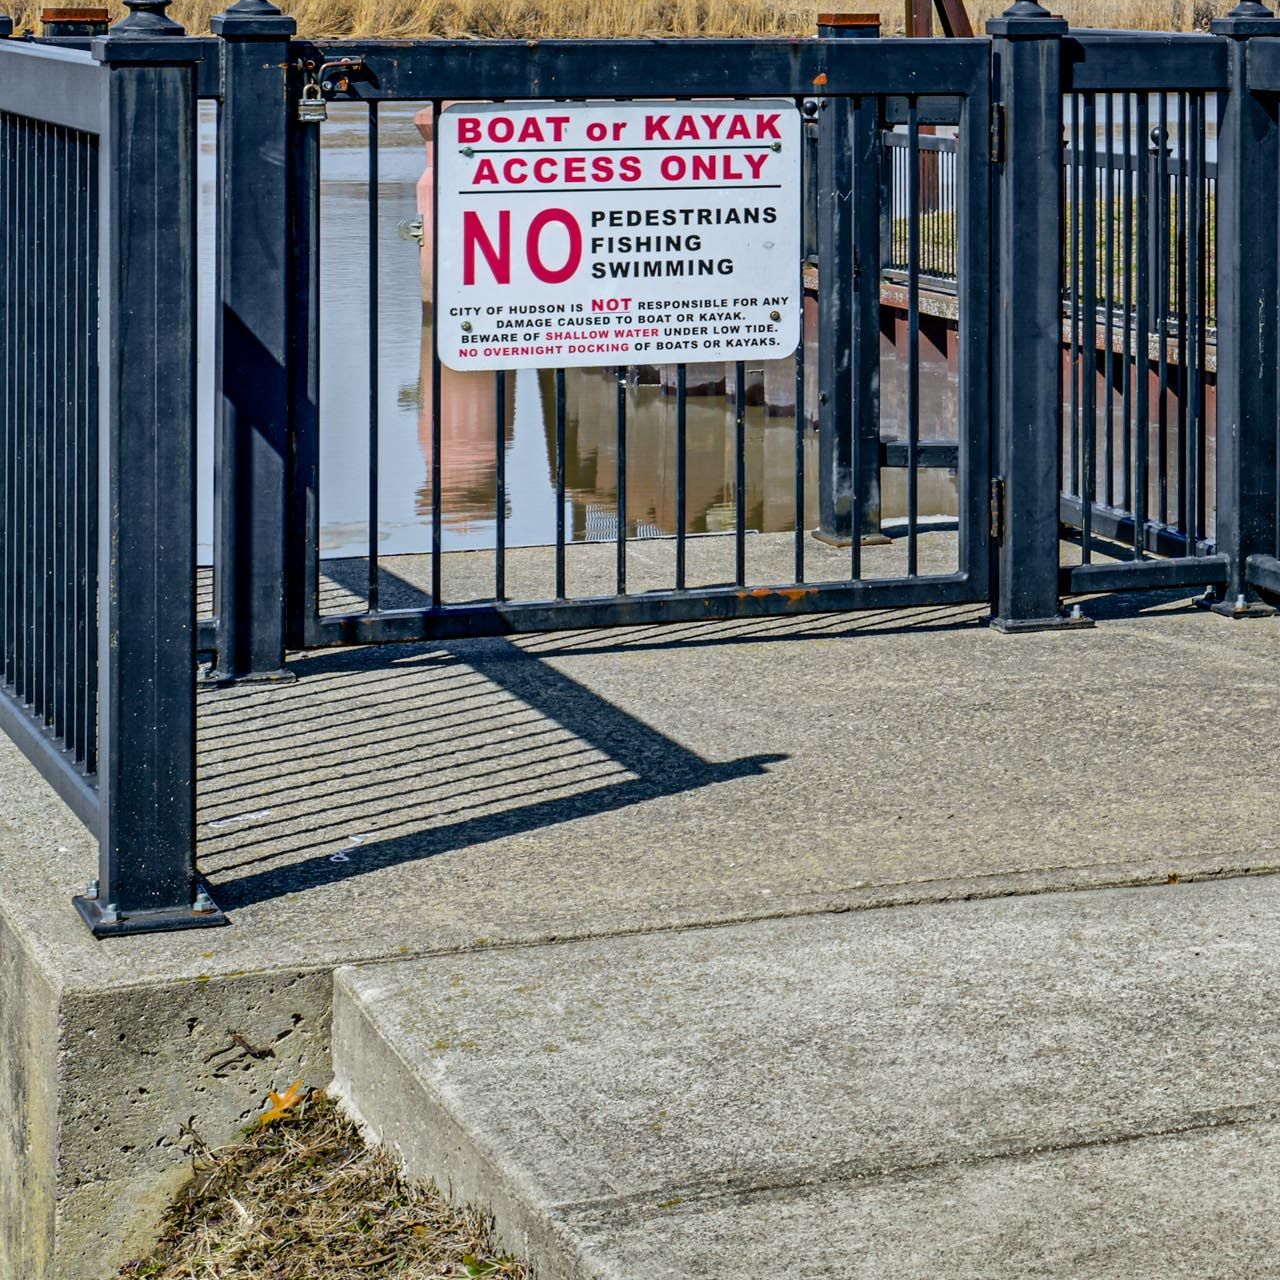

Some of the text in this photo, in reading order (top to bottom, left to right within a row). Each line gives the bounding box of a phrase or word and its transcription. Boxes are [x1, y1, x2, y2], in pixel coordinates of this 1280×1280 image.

[458, 114, 782, 144] BOAT or KAYAK
[472, 154, 769, 185] ACCESS ONLY
[591, 207, 777, 227] PEDESTRIANS
[463, 208, 582, 286] NO
[591, 235, 701, 254] FISHING
[592, 258, 733, 279] SWIMMING
[450, 297, 789, 316] CITY OF HUDSON IS NOT RESPONSIBLE FOR ANY
[497, 312, 746, 329] DAMAGE CAUSED TO BOAT OR KAYAK.
[461, 324, 778, 344] BEWARE OF SHALLOW WATER UNDER LOW TIDE.
[459, 337, 780, 357] NO OVERNIGHT DOCKING OF BOATS OR KAYAKS.
